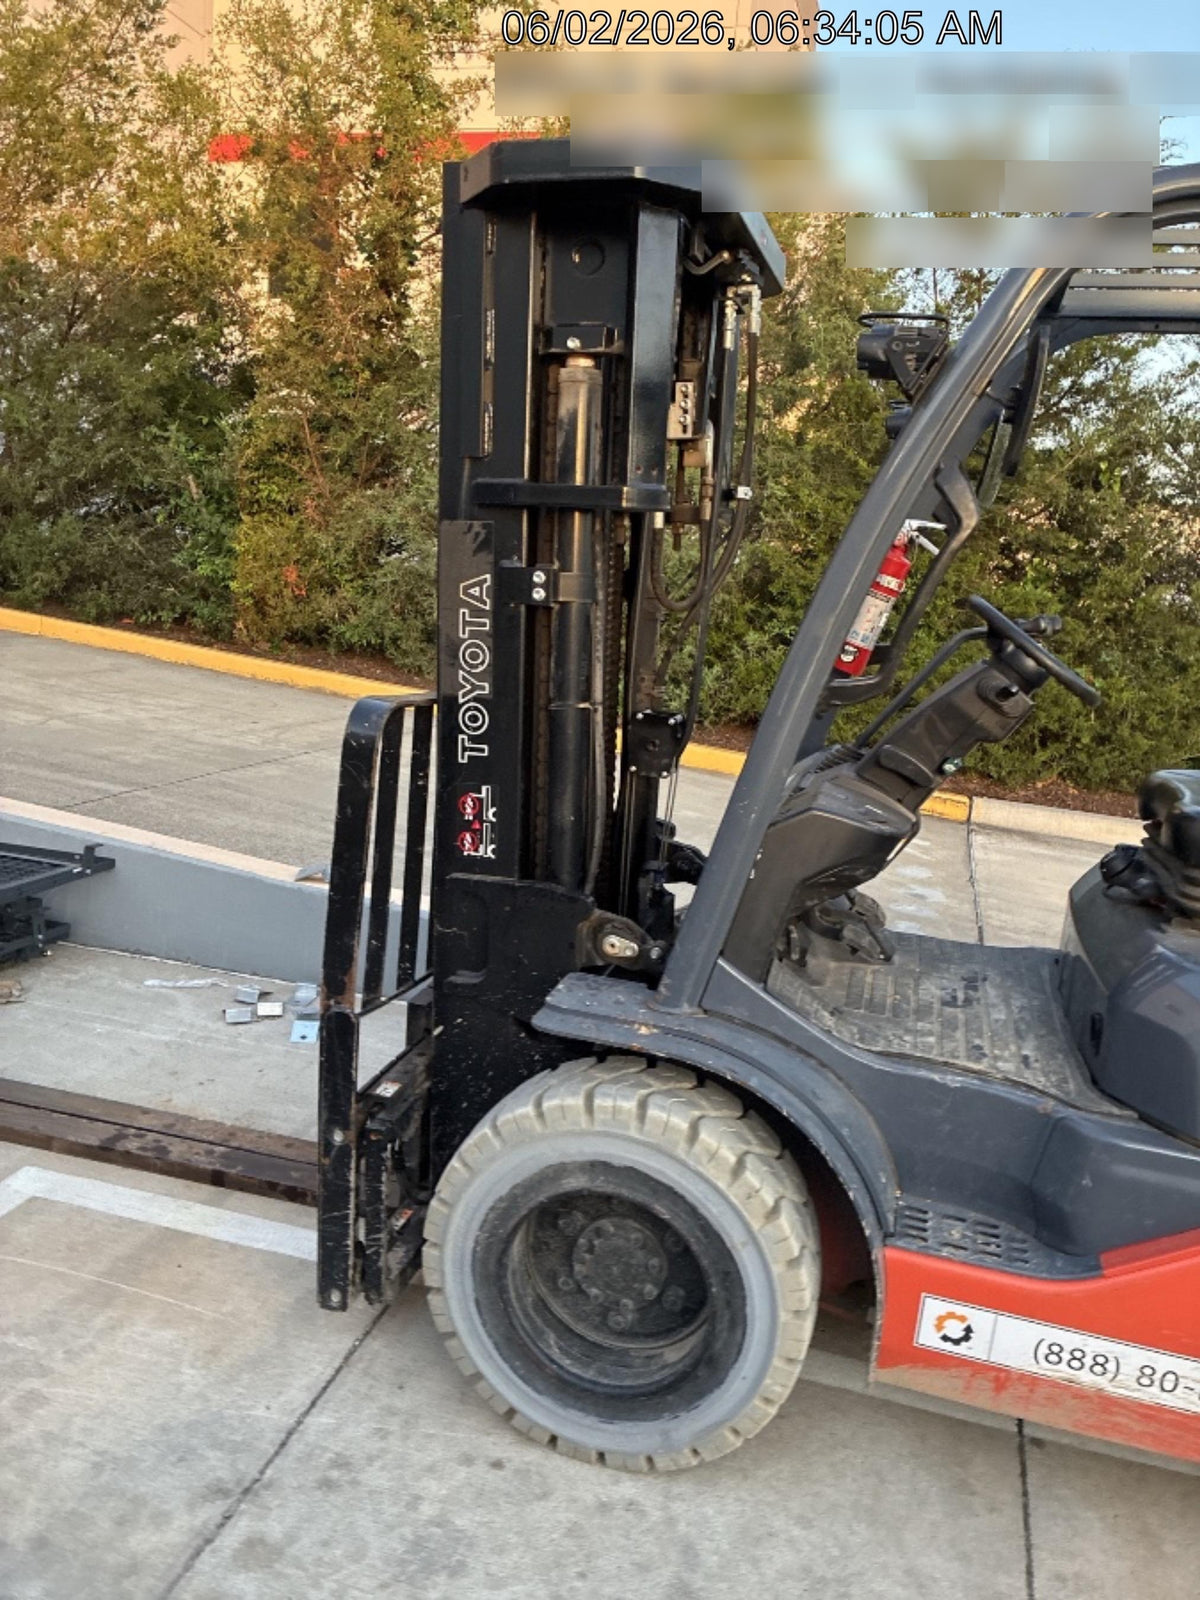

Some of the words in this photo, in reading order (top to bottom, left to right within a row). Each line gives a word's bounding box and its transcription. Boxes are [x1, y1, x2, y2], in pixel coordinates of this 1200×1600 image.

[458, 573, 491, 764] TOYOTA
[1034, 1338, 1120, 1382] (888)
[1136, 1364, 1200, 1401] 80-
